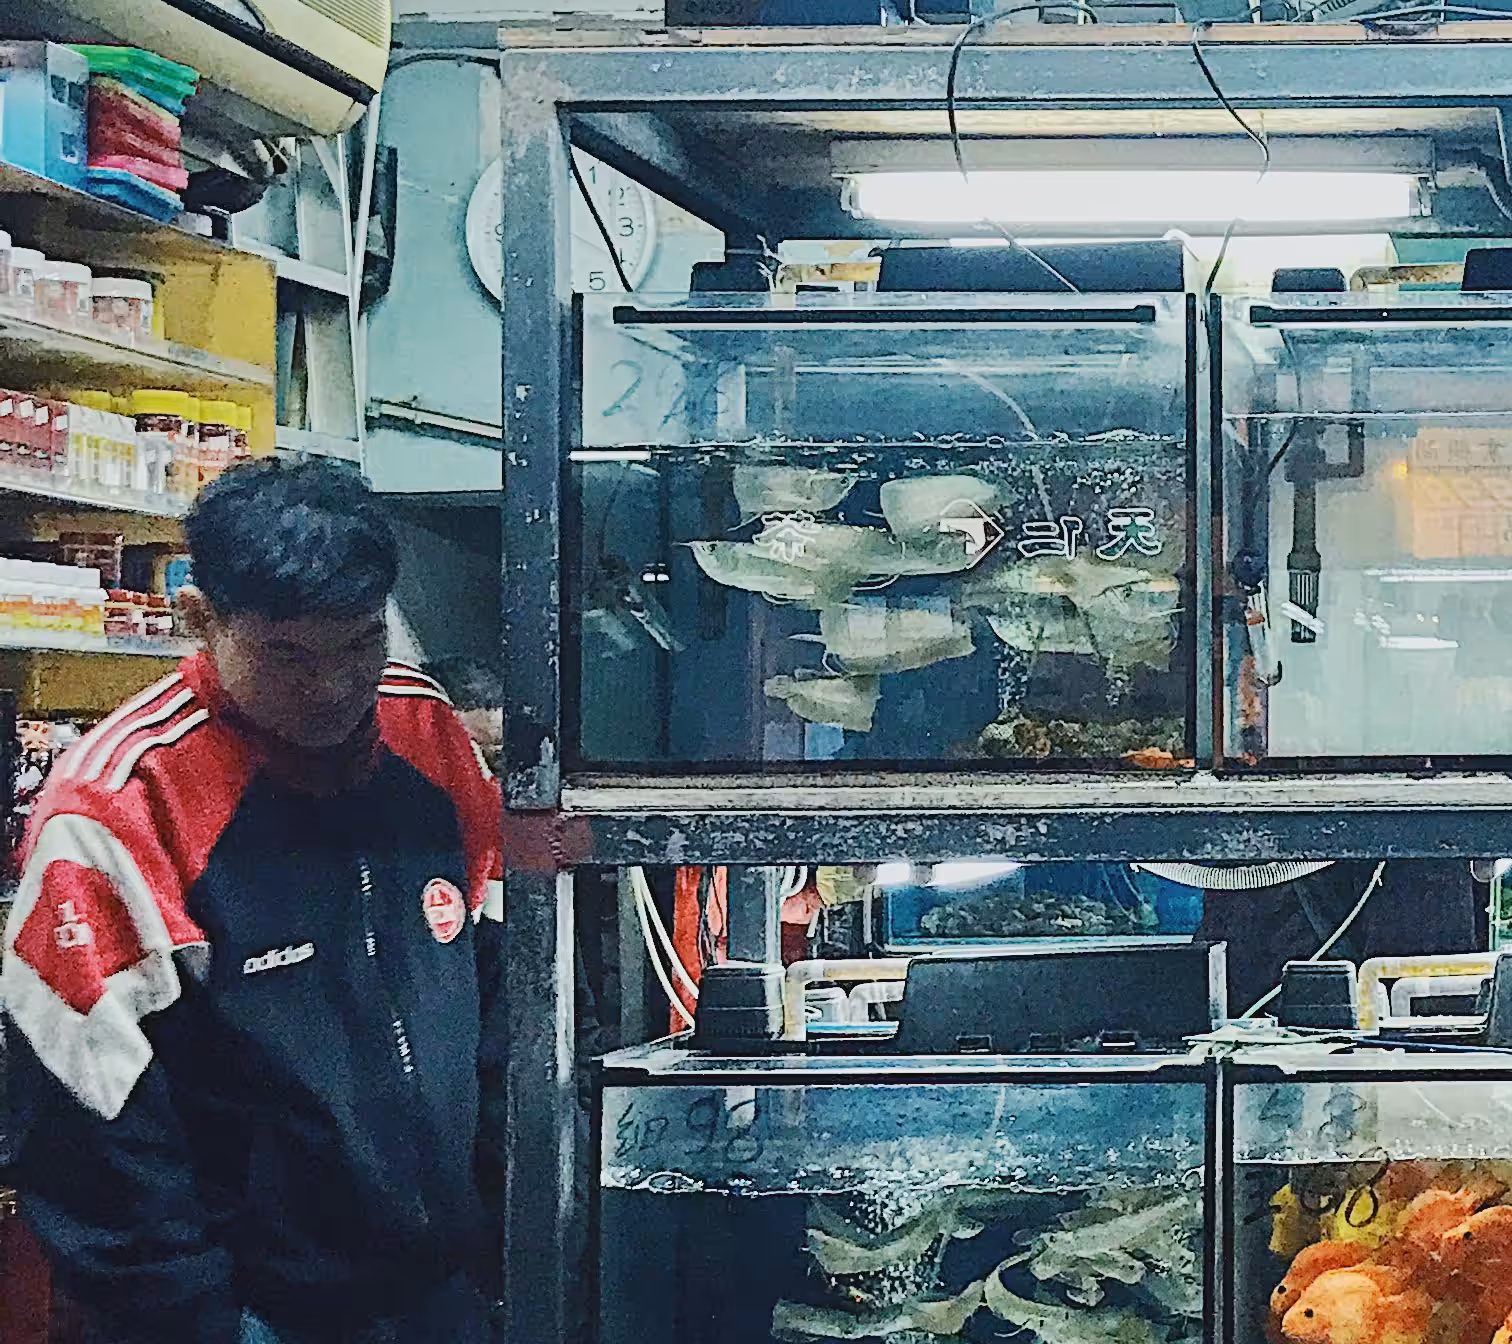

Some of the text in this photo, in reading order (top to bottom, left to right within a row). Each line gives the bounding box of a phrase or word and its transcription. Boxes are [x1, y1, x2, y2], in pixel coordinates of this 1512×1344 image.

[618, 216, 634, 237] 3
[588, 270, 606, 291] 5
[243, 942, 315, 974] adidas
